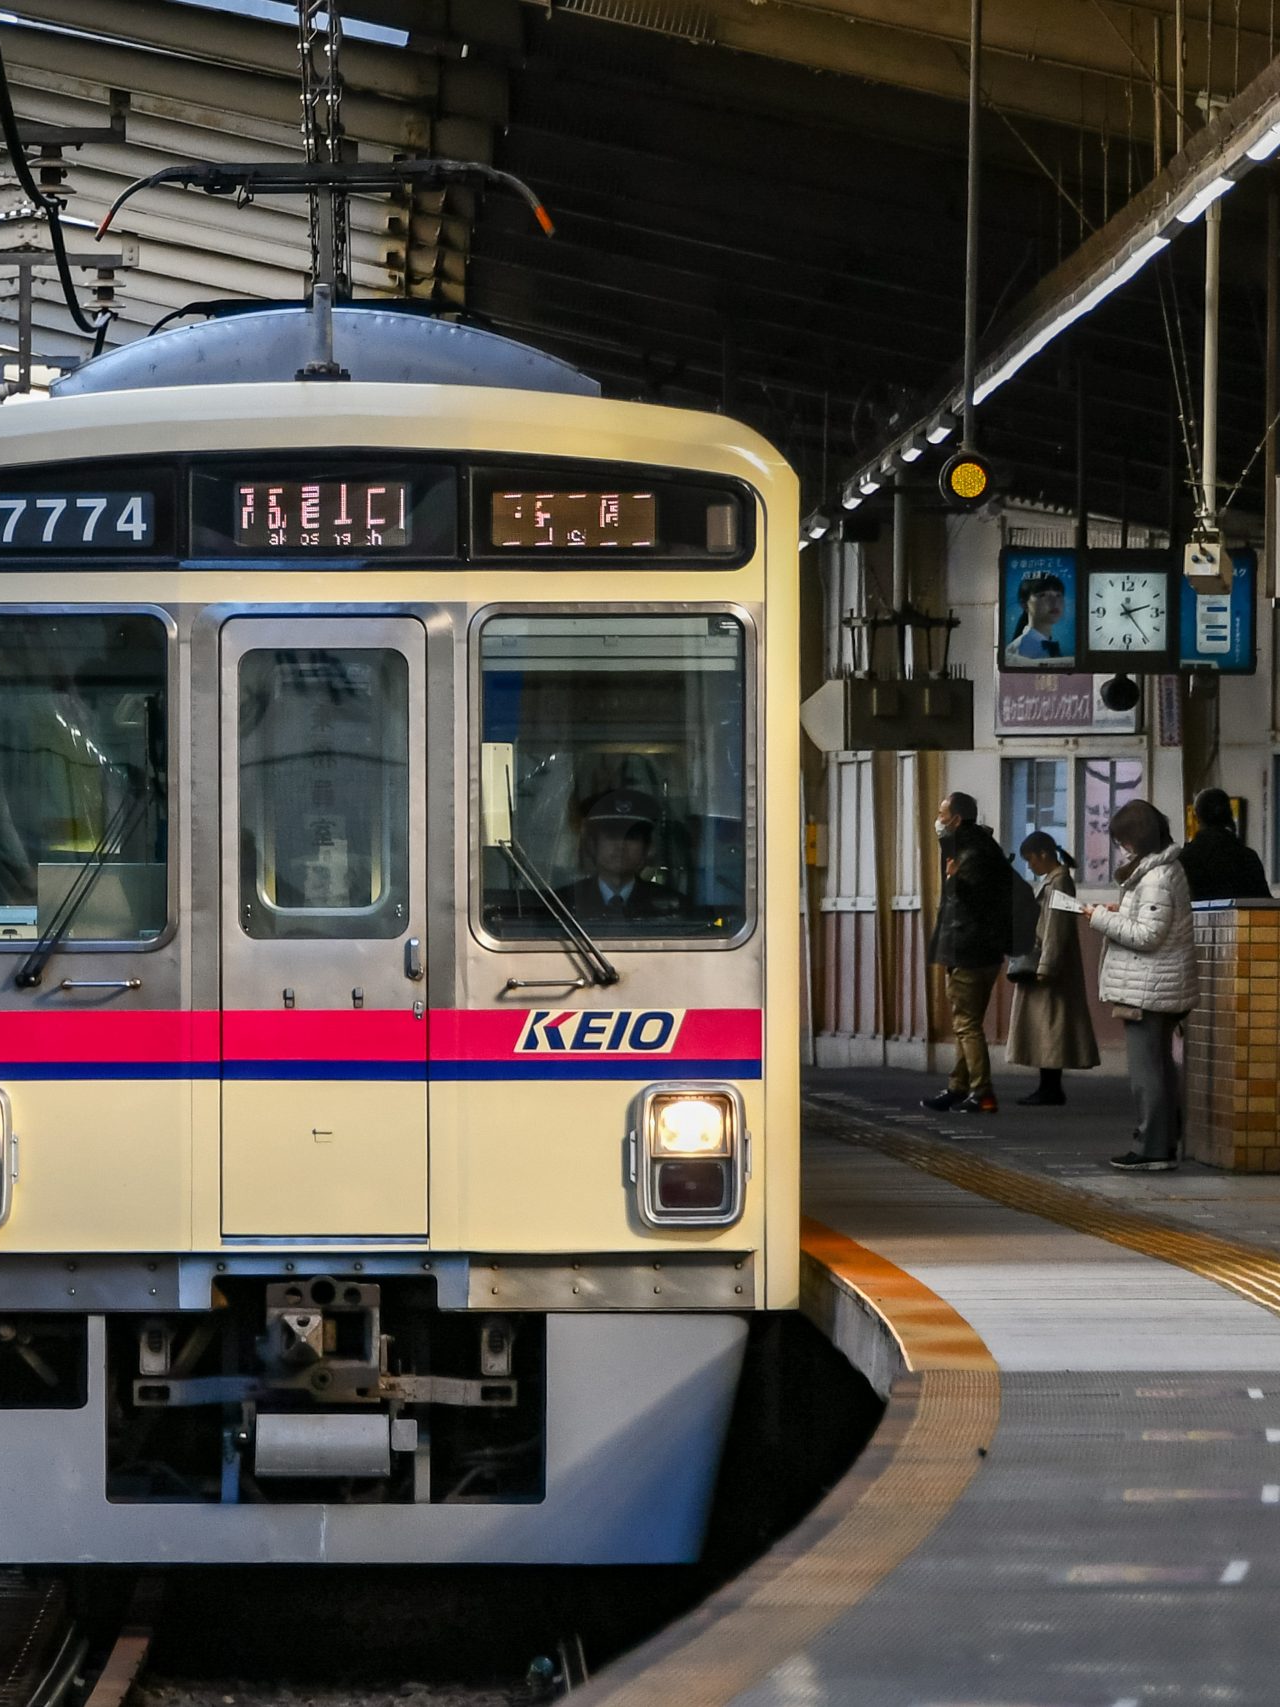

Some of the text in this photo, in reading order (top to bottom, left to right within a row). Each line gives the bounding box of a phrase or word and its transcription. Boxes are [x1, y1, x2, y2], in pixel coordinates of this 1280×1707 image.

[1120, 581, 1136, 592] 12
[1096, 606, 1108, 618] 9
[1150, 607, 1160, 619] 3
[1122, 633, 1133, 645] 6
[522, 1011, 675, 1051] KEIO
